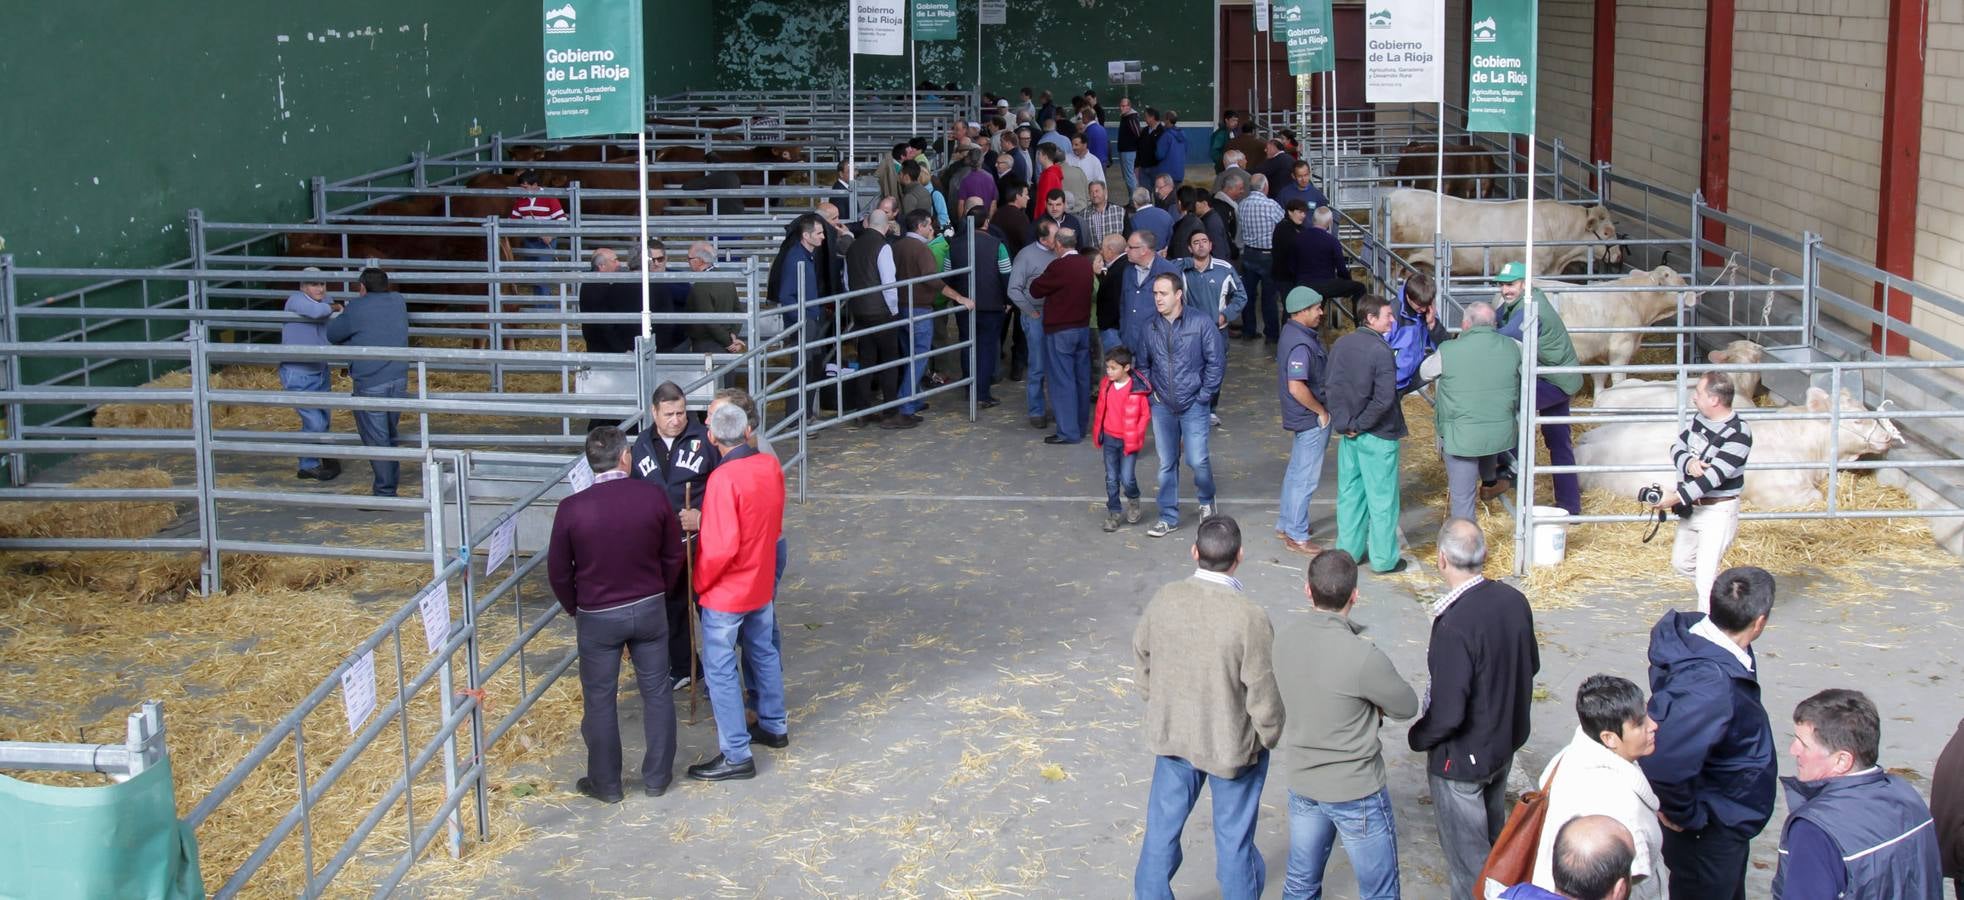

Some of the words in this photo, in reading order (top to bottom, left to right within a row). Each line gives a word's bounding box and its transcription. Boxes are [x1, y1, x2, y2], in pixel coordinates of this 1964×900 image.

[858, 5, 894, 14] Gobierno
[1288, 27, 1320, 37] Gobierno
[1369, 40, 1422, 50] Gobierno
[546, 48, 614, 63] Gobierno
[1369, 52, 1383, 62] de
[1387, 52, 1400, 62] La
[1404, 52, 1433, 64] Rioja
[1472, 54, 1521, 68] Gobierno
[546, 67, 565, 81] de
[570, 66, 588, 80] La
[590, 64, 629, 81] Rioja
[1472, 71, 1488, 83] de
[1490, 70, 1504, 83] La
[1508, 70, 1528, 86] Rioja
[546, 88, 582, 96] Agricultura,
